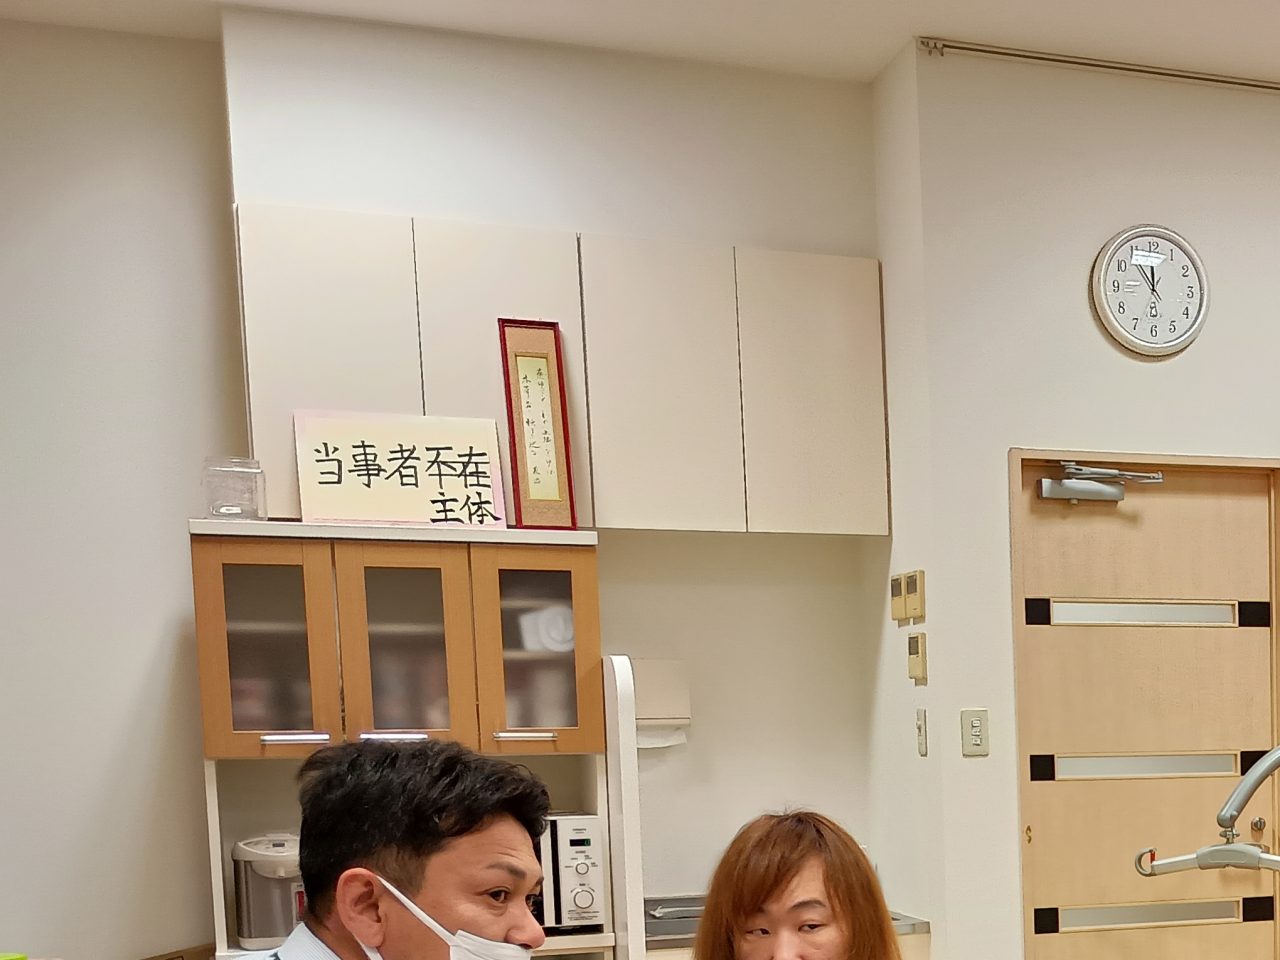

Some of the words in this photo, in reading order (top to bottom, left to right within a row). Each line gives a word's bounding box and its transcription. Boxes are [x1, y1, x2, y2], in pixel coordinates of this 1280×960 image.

[1148, 241, 1160, 254] 12
[1170, 248, 1174, 262] 1
[1117, 259, 1127, 272] 10
[1181, 264, 1189, 278] 2
[1112, 279, 1120, 293] 9
[1186, 285, 1194, 299] 3
[1117, 301, 1126, 315] 8
[1182, 306, 1190, 320] 4
[1131, 317, 1139, 331] 7
[1150, 324, 1158, 338] 6
[1168, 320, 1177, 333] 5
[313, 440, 492, 489] 当事者不在
[429, 491, 503, 525] 主体
